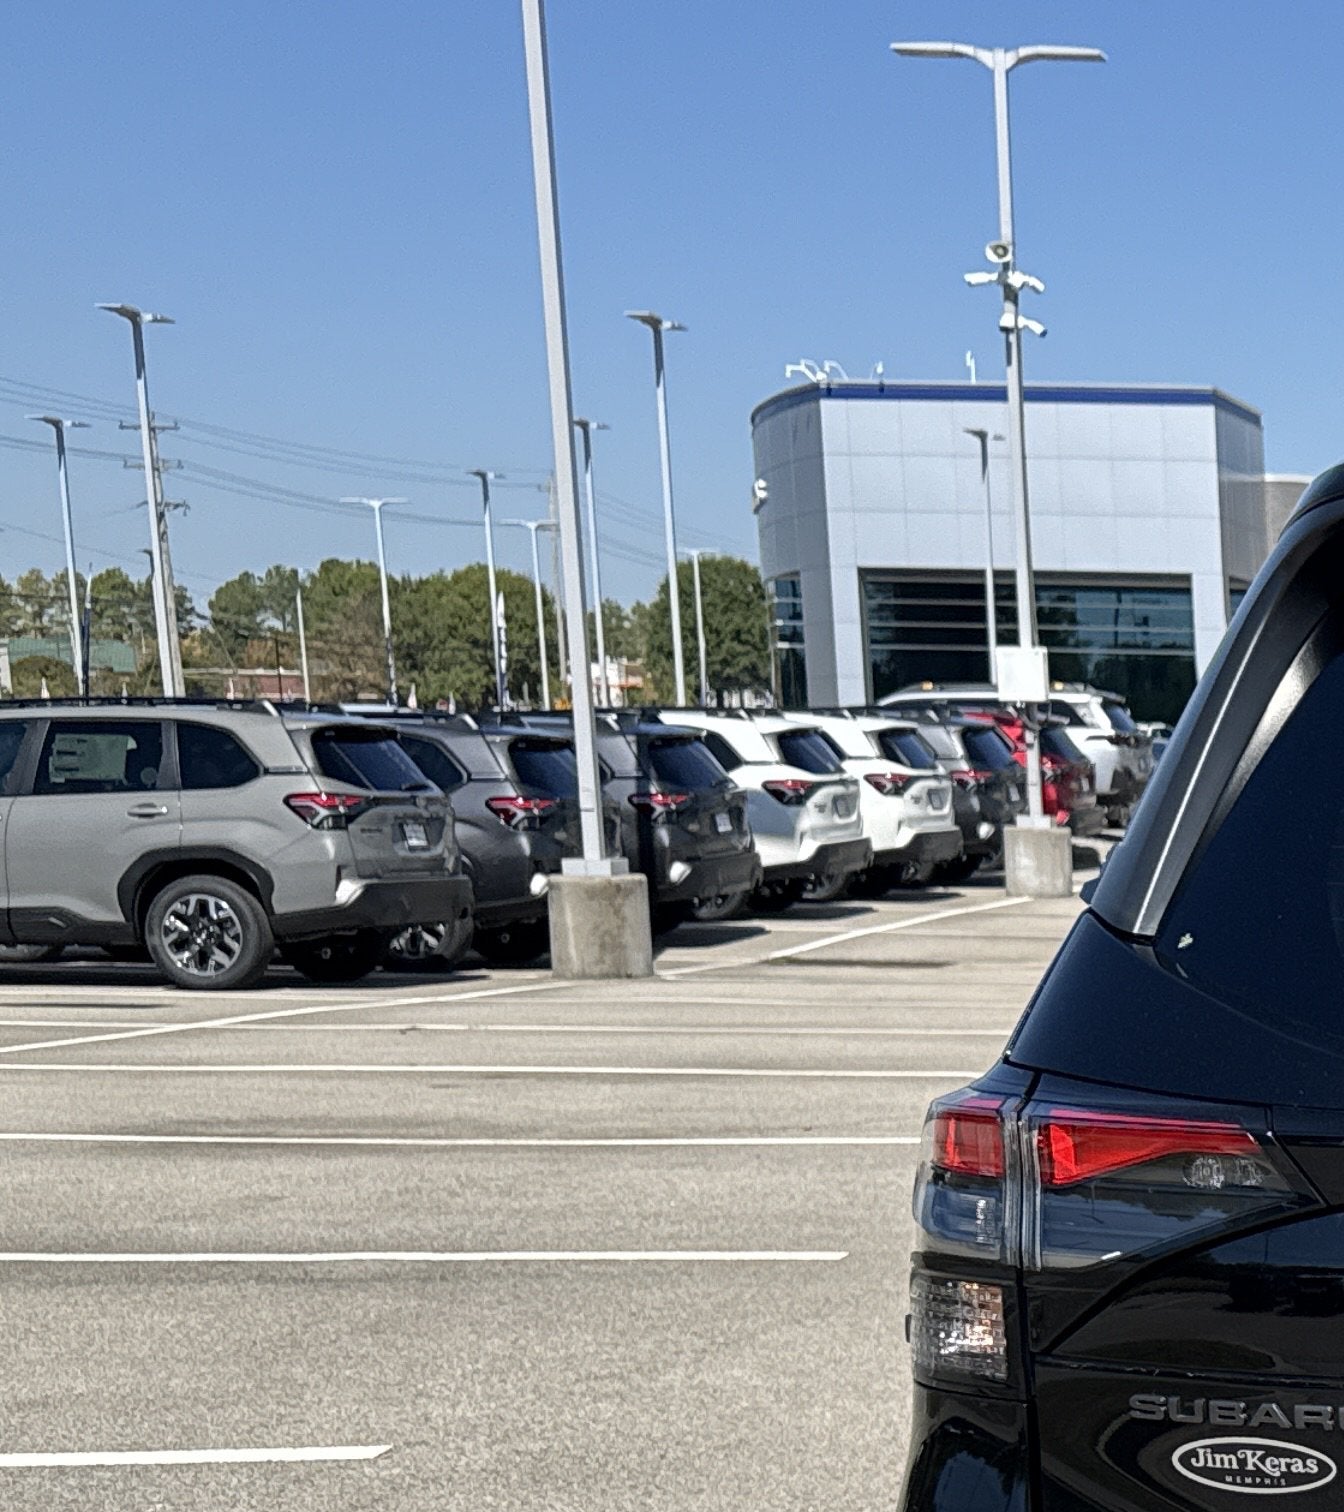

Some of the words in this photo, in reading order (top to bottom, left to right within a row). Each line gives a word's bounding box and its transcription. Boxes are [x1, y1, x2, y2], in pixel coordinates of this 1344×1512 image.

[1190, 1447, 1238, 1471] Jim
[1238, 1448, 1319, 1477] Keras
[1225, 1475, 1287, 1487] MEMPHIS
